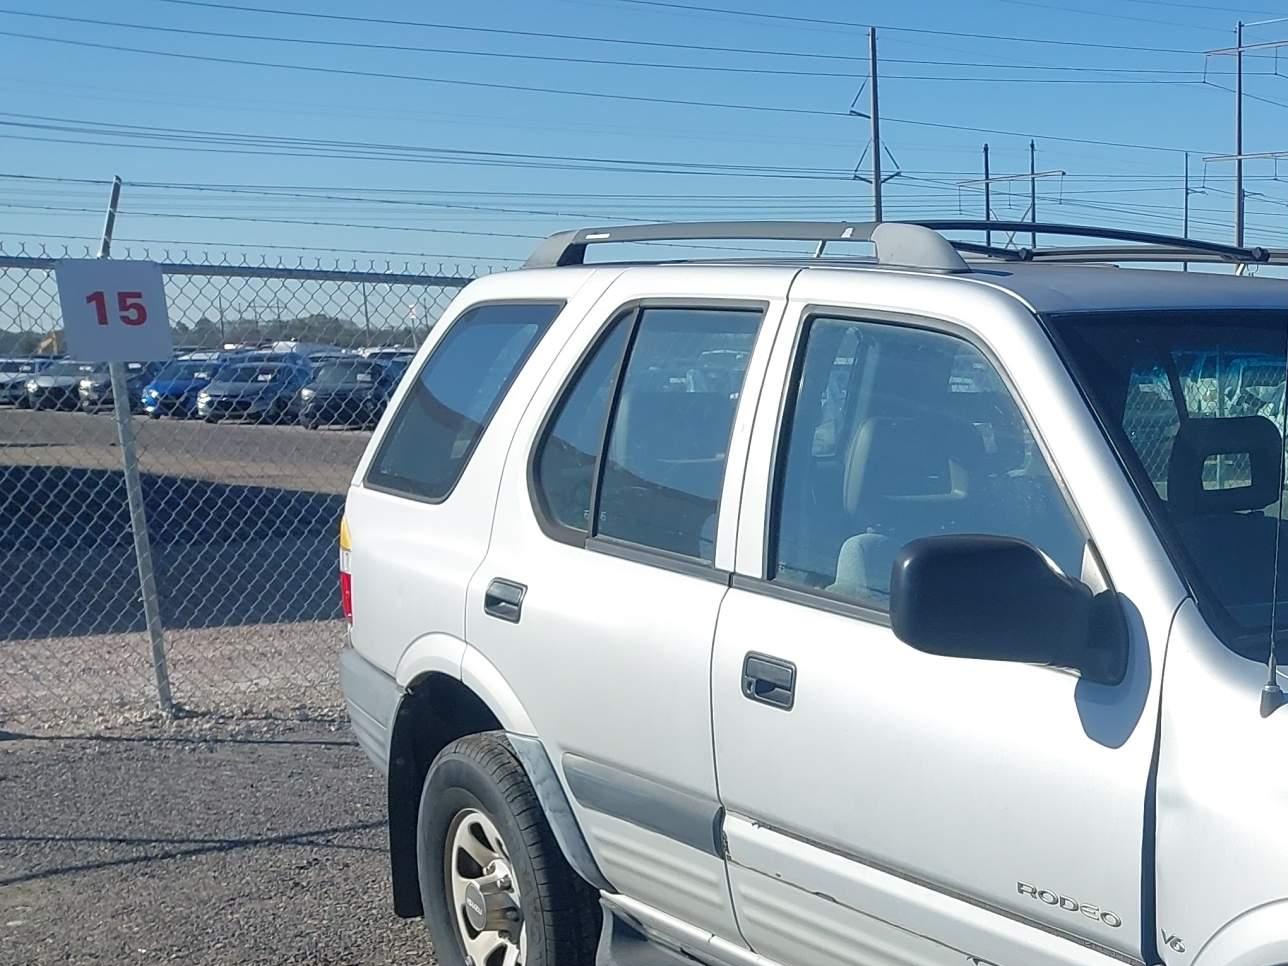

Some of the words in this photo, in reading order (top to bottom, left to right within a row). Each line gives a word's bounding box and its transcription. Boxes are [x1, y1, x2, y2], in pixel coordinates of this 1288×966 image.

[85, 291, 148, 326] 15
[1016, 880, 1122, 928] RODEO
[1160, 928, 1186, 953] V6
